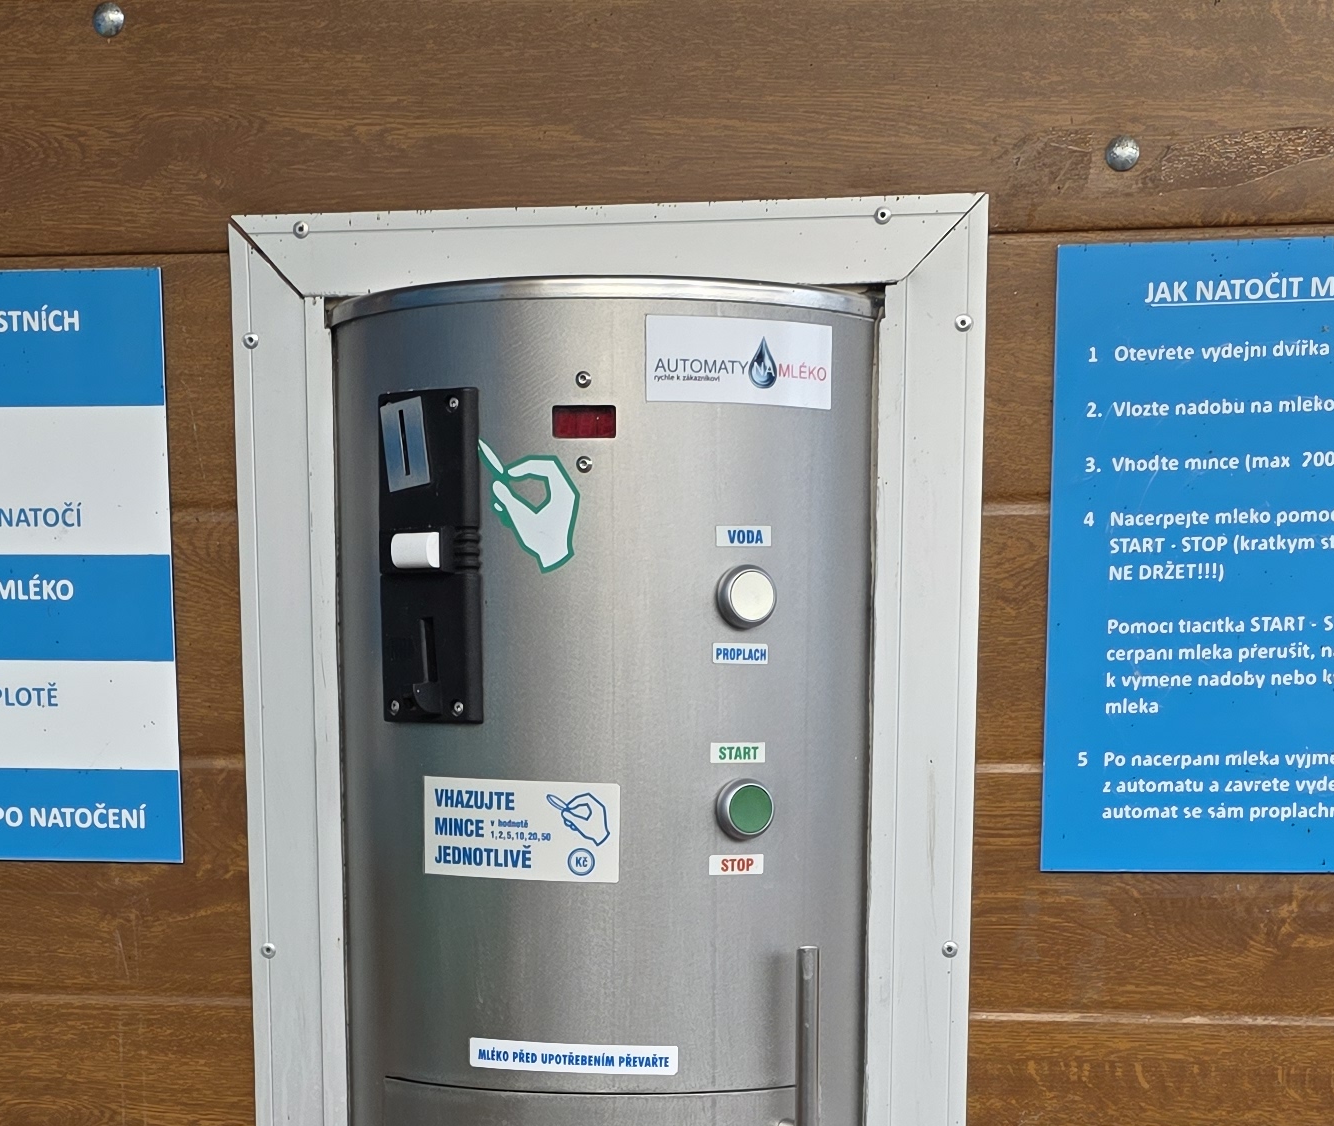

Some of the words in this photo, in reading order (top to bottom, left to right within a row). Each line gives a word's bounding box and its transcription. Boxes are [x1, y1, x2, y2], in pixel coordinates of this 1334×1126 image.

[1145, 281, 1188, 304] JAK
[1195, 271, 1305, 300] NATOČIT
[1089, 347, 1097, 362] 1
[1273, 340, 1329, 356] dvířka
[654, 358, 749, 375] AUTOMATY
[752, 361, 775, 376] NA
[778, 362, 827, 382] MLÉKO
[1087, 402, 1102, 417] 2.
[1251, 401, 1272, 413] na
[1085, 457, 1101, 472] 3.
[1246, 454, 1290, 472] (max
[1084, 512, 1094, 526] 4
[728, 530, 763, 544] VODA
[1110, 538, 1165, 553] START
[1182, 536, 1227, 552] STOP
[1109, 565, 1133, 580] NE
[1139, 561, 1224, 582] DRŽET!!!)
[1251, 616, 1305, 632] START
[716, 648, 766, 661] PROPLACH
[1107, 672, 1115, 687] k
[1271, 670, 1316, 685] nebo
[719, 746, 759, 760] START
[1078, 752, 1087, 766] 5
[1104, 752, 1125, 766] Po
[1103, 782, 1110, 792] z
[1117, 779, 1203, 792] automatu
[1209, 781, 1219, 792] a
[434, 788, 515, 810] VHAZUJTE
[30, 803, 146, 828] NATOČENÍ
[1102, 805, 1178, 818] automat
[1184, 807, 1202, 818] se
[434, 817, 484, 838] MINCE
[498, 819, 528, 828] hodnotě
[435, 845, 532, 868] JEDNOTLIVĚ
[575, 856, 588, 867] Kč
[721, 858, 754, 872] STOP
[478, 1047, 508, 1062] MLÉKO
[513, 1050, 537, 1063] PŘED
[541, 1052, 615, 1066] UPOTŘEBENÍM
[619, 1054, 669, 1068] PŘEVAŘTE
